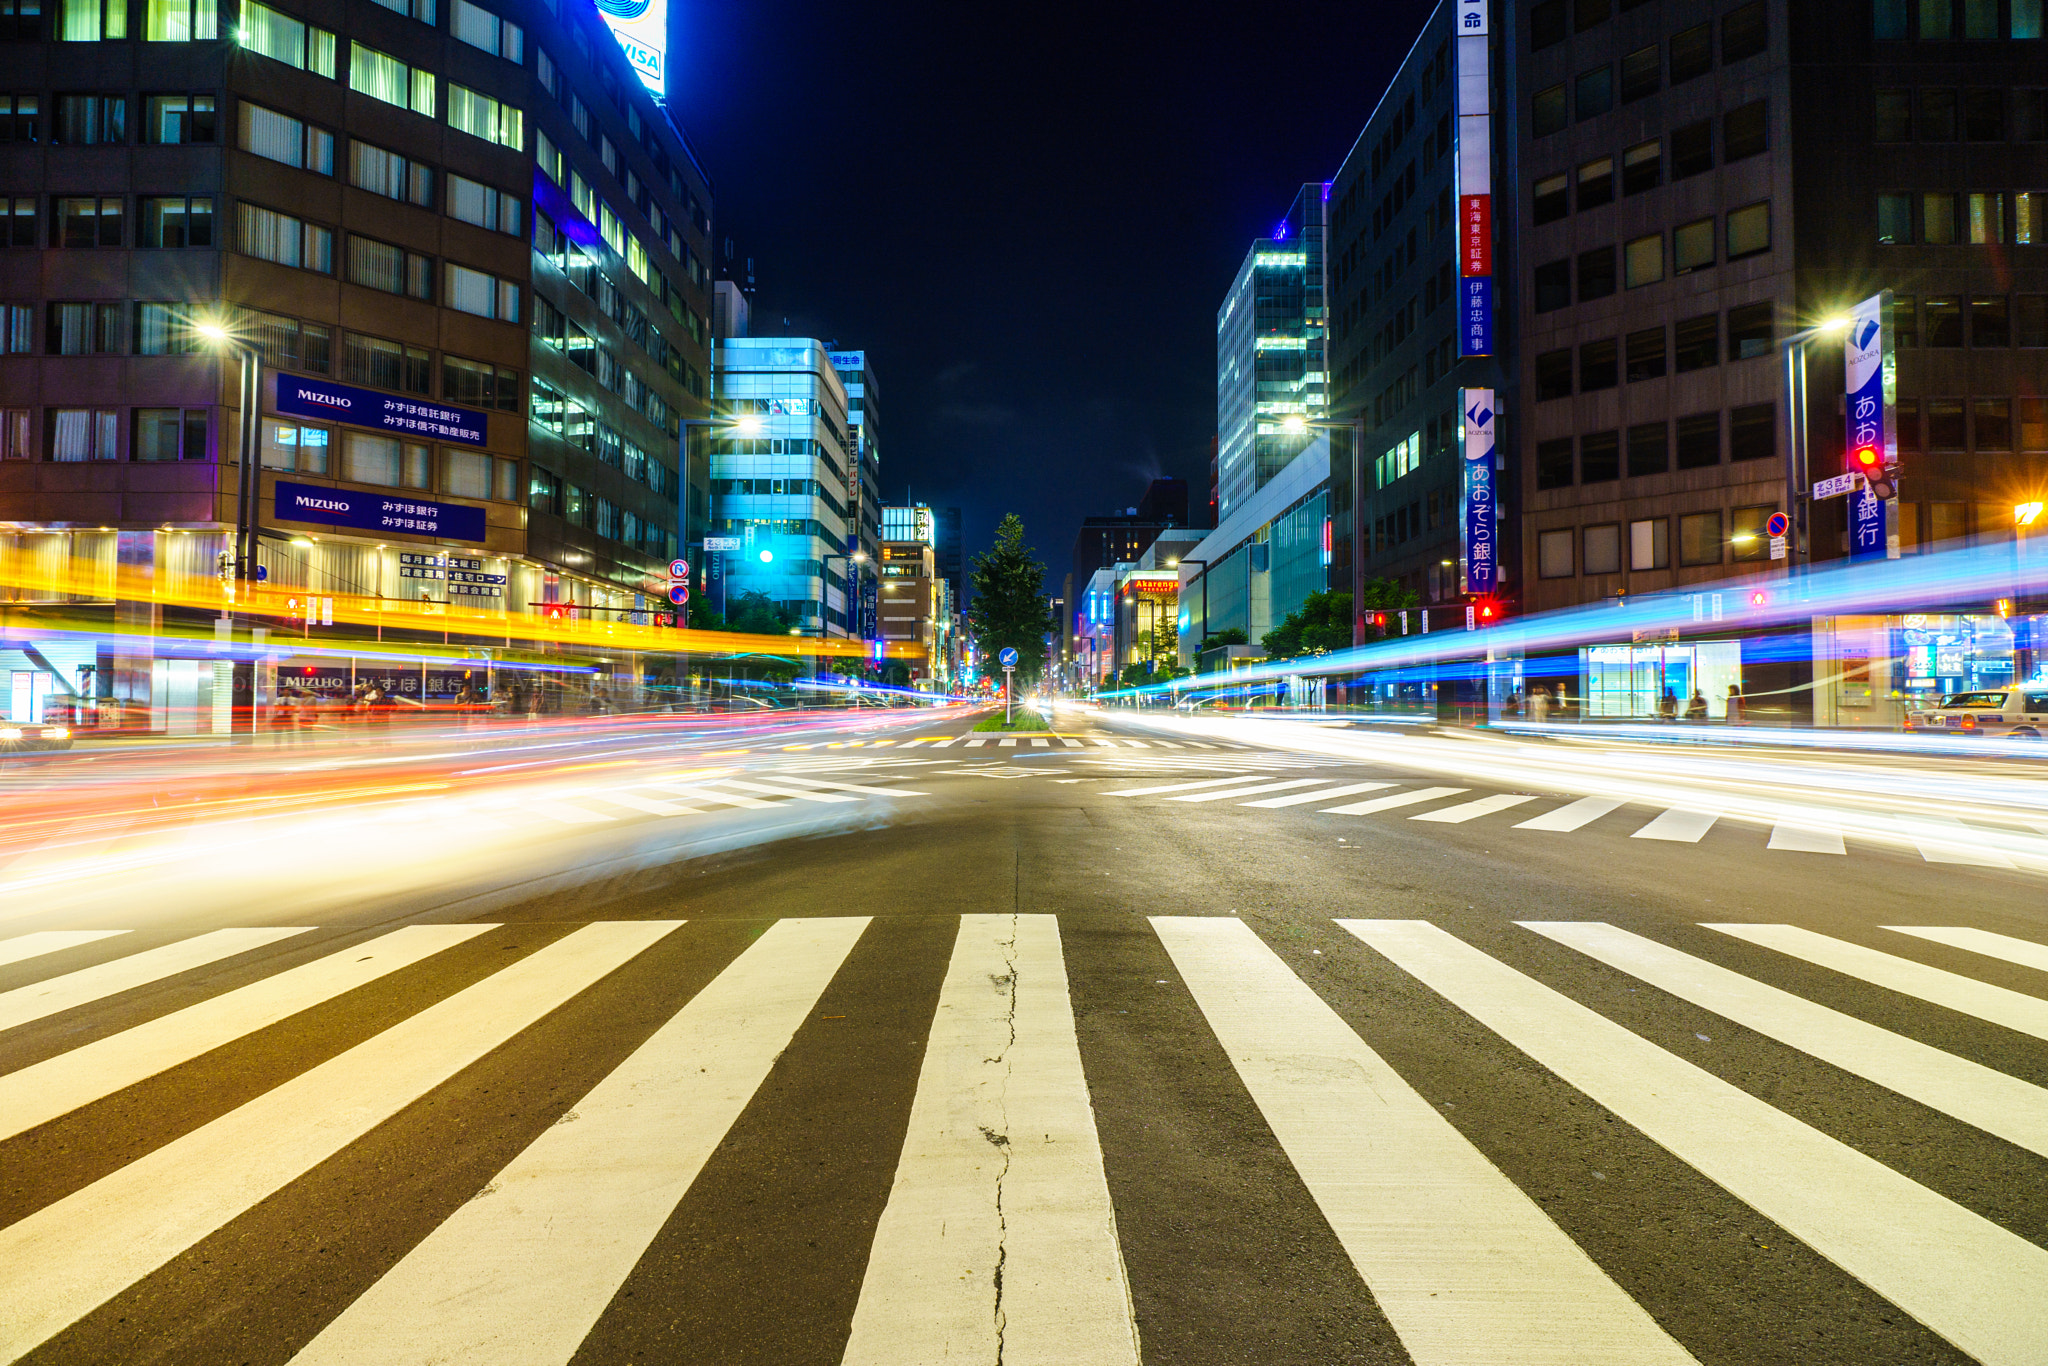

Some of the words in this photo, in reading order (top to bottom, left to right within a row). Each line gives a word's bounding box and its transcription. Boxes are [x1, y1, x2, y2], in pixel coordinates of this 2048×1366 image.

[1463, 0, 1481, 28] 命
[1470, 199, 1482, 272] 東海東京証券
[1470, 282, 1483, 351] 伊藤忠商事
[1848, 349, 1879, 367] AOZORA
[297, 389, 352, 408] MIZUHO
[384, 400, 460, 423] みずほ信託銀行
[383, 415, 480, 441] みずほ信不動産販売
[296, 496, 350, 512] MIZUHO
[382, 501, 438, 517] みずほ銀行
[382, 516, 438, 531] みずほ証券
[1472, 463, 1491, 580] あおぞら銀行
[1136, 580, 1179, 589] Akarenga
[285, 676, 343, 687] MIZUHO
